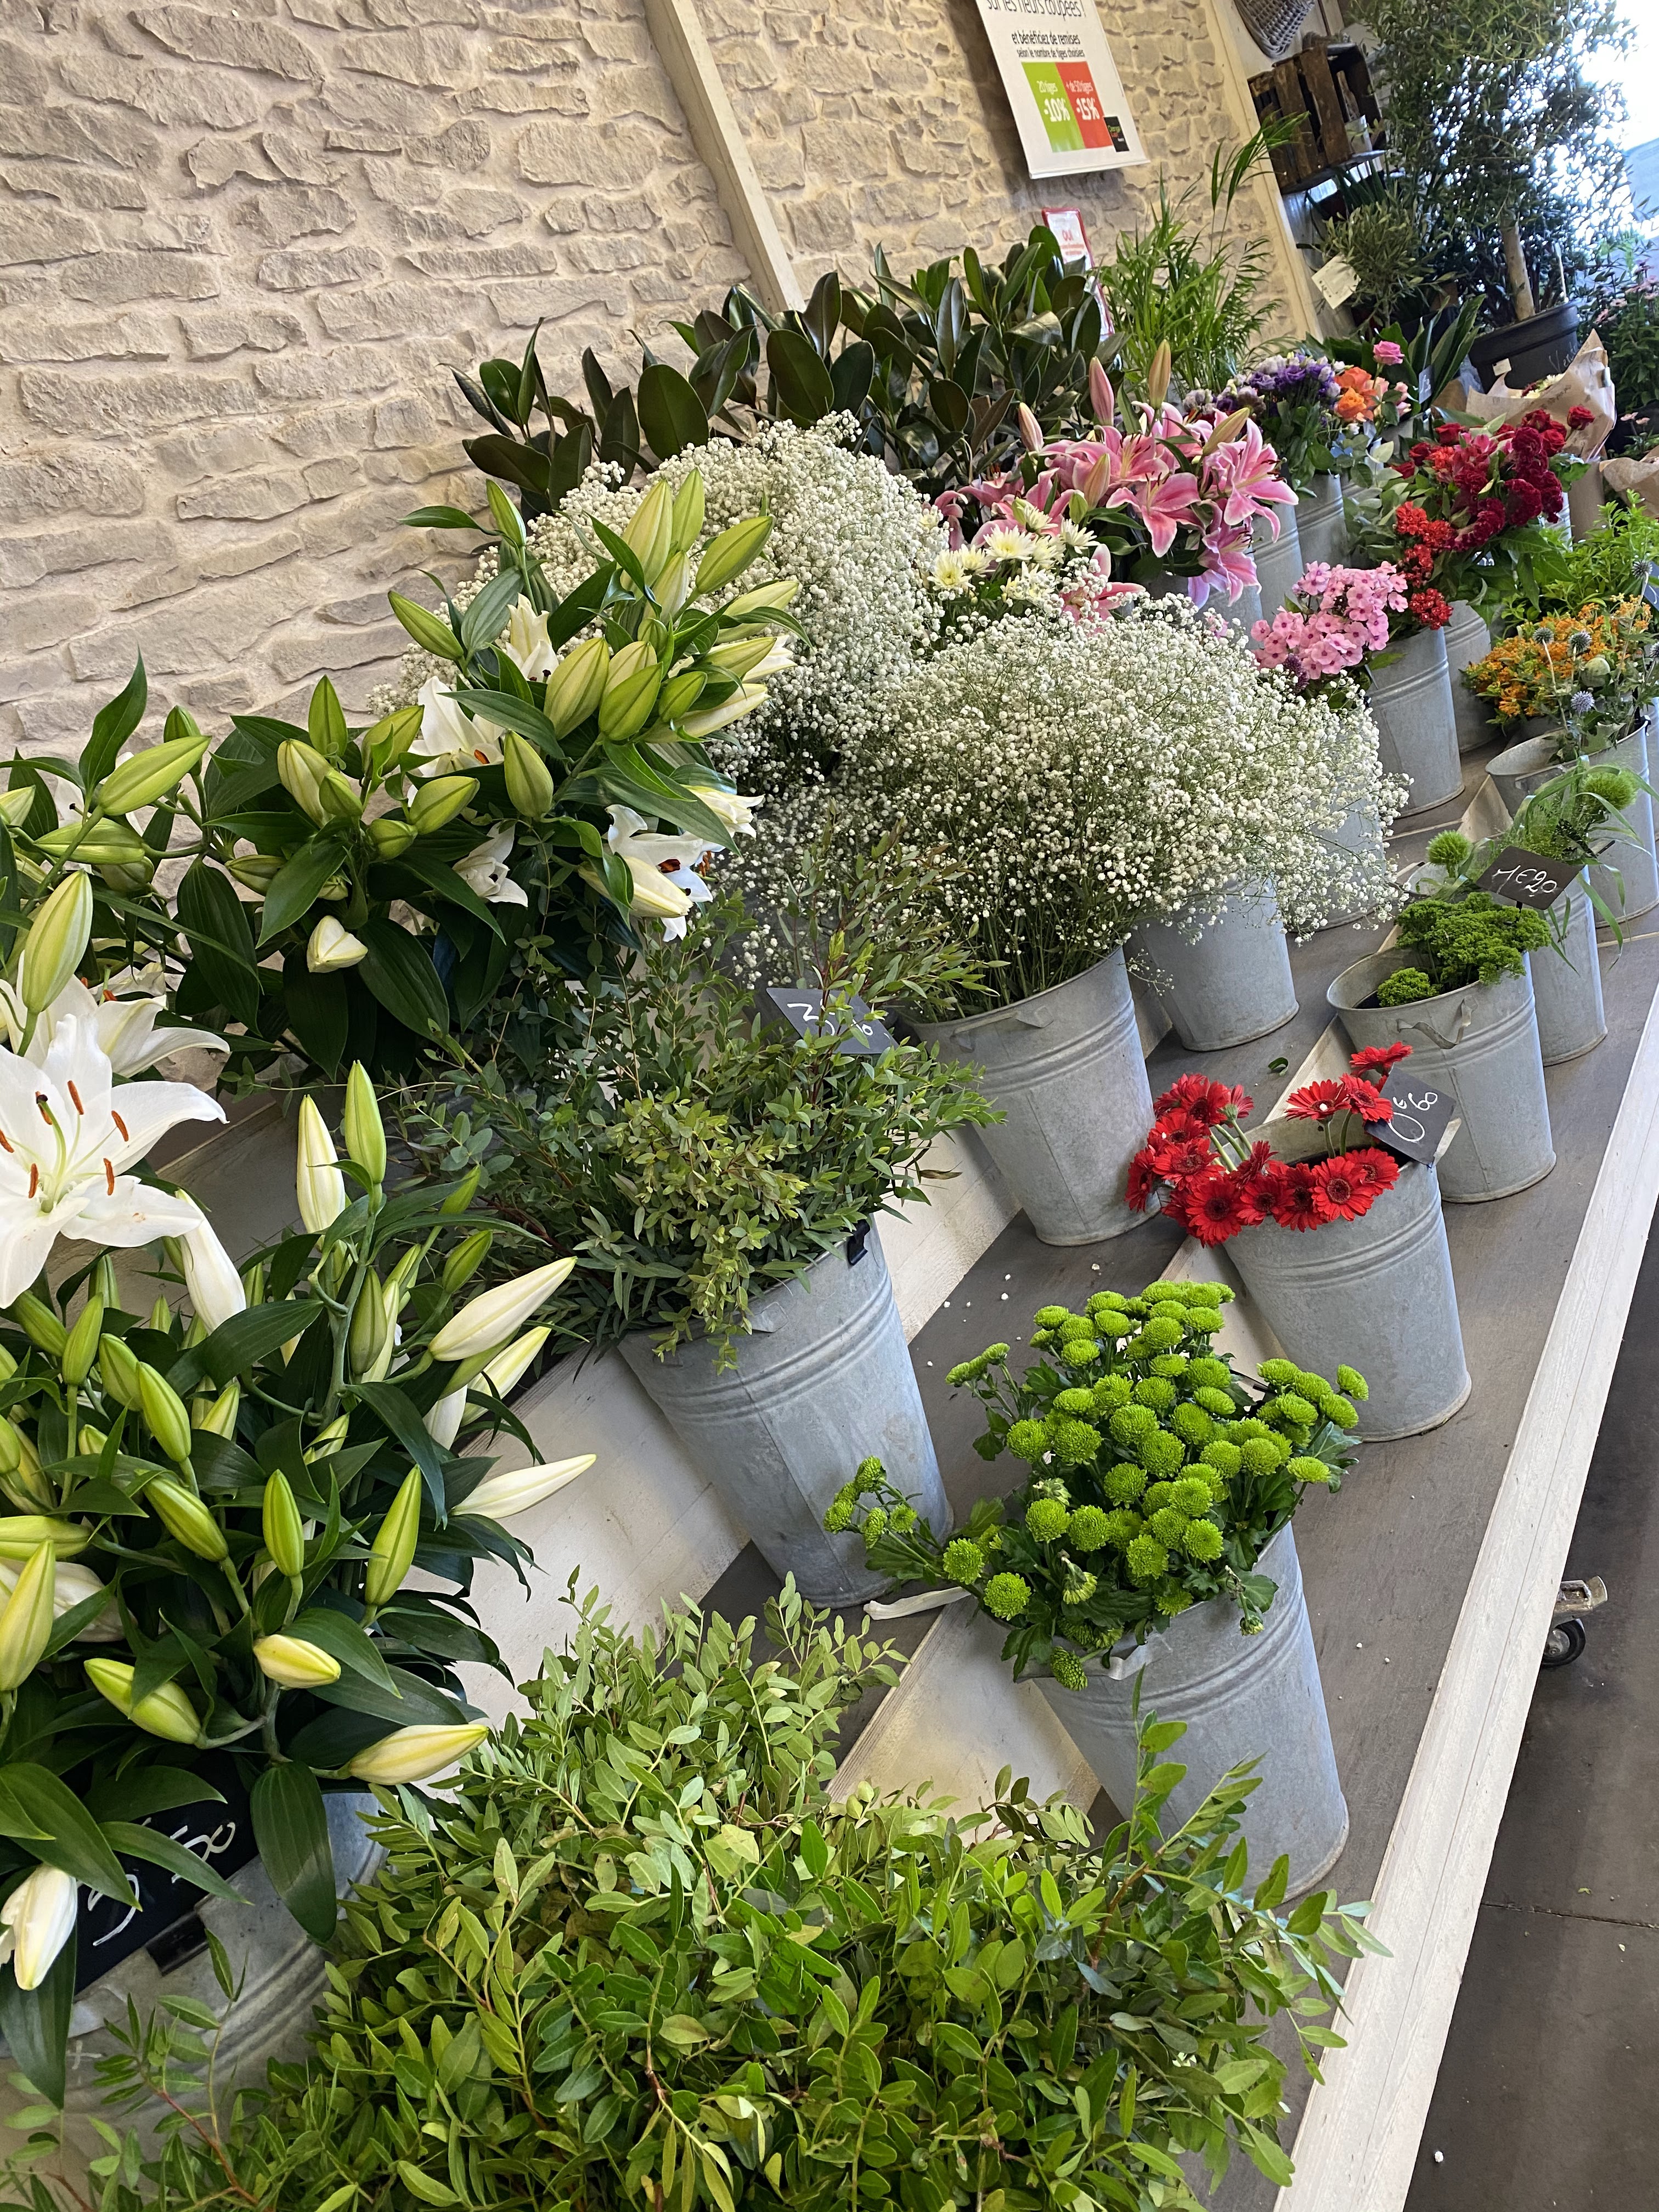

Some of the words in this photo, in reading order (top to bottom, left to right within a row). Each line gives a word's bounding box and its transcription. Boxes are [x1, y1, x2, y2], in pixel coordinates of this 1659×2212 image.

[1012, 31, 1020, 44] et
[1017, 30, 1050, 44] bénéficiez
[1049, 30, 1058, 44] de
[1058, 31, 1080, 44] remises
[1034, 47, 1051, 58] nombre
[1056, 47, 1068, 60] tiges
[1067, 47, 1085, 58] choisies
